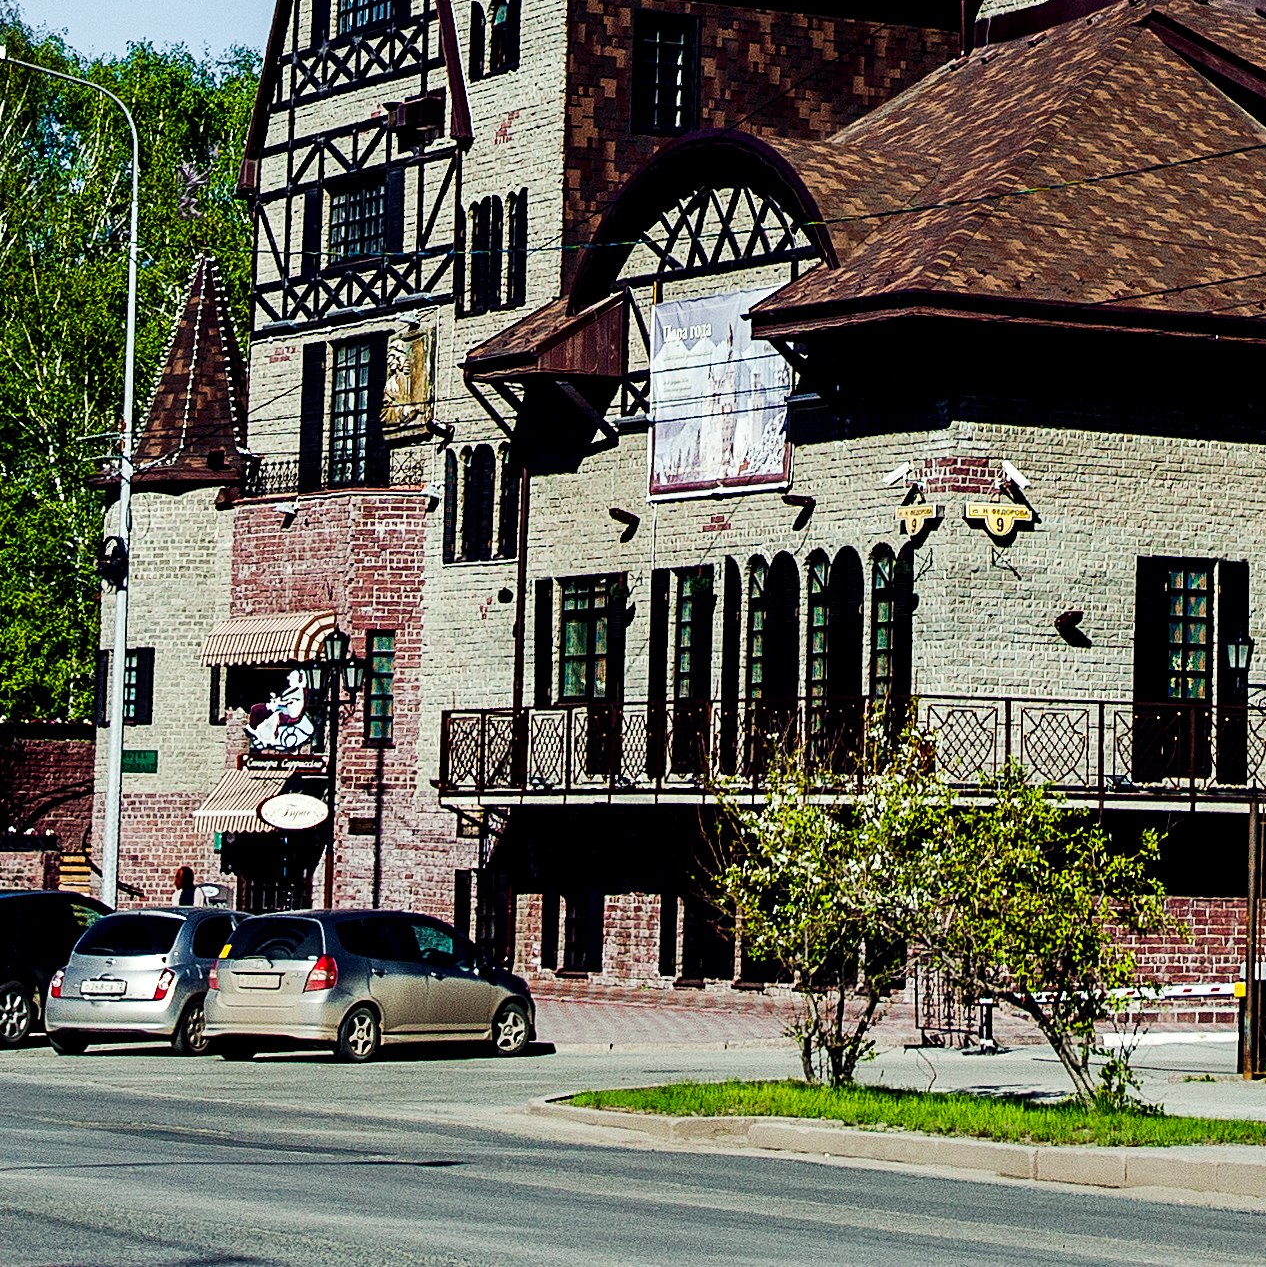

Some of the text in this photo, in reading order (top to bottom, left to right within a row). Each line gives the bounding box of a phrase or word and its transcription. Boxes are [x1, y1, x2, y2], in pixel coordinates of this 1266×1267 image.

[991, 508, 1029, 517] ФЕДОРОВА
[911, 518, 917, 533] 9
[996, 517, 1004, 533] 9
